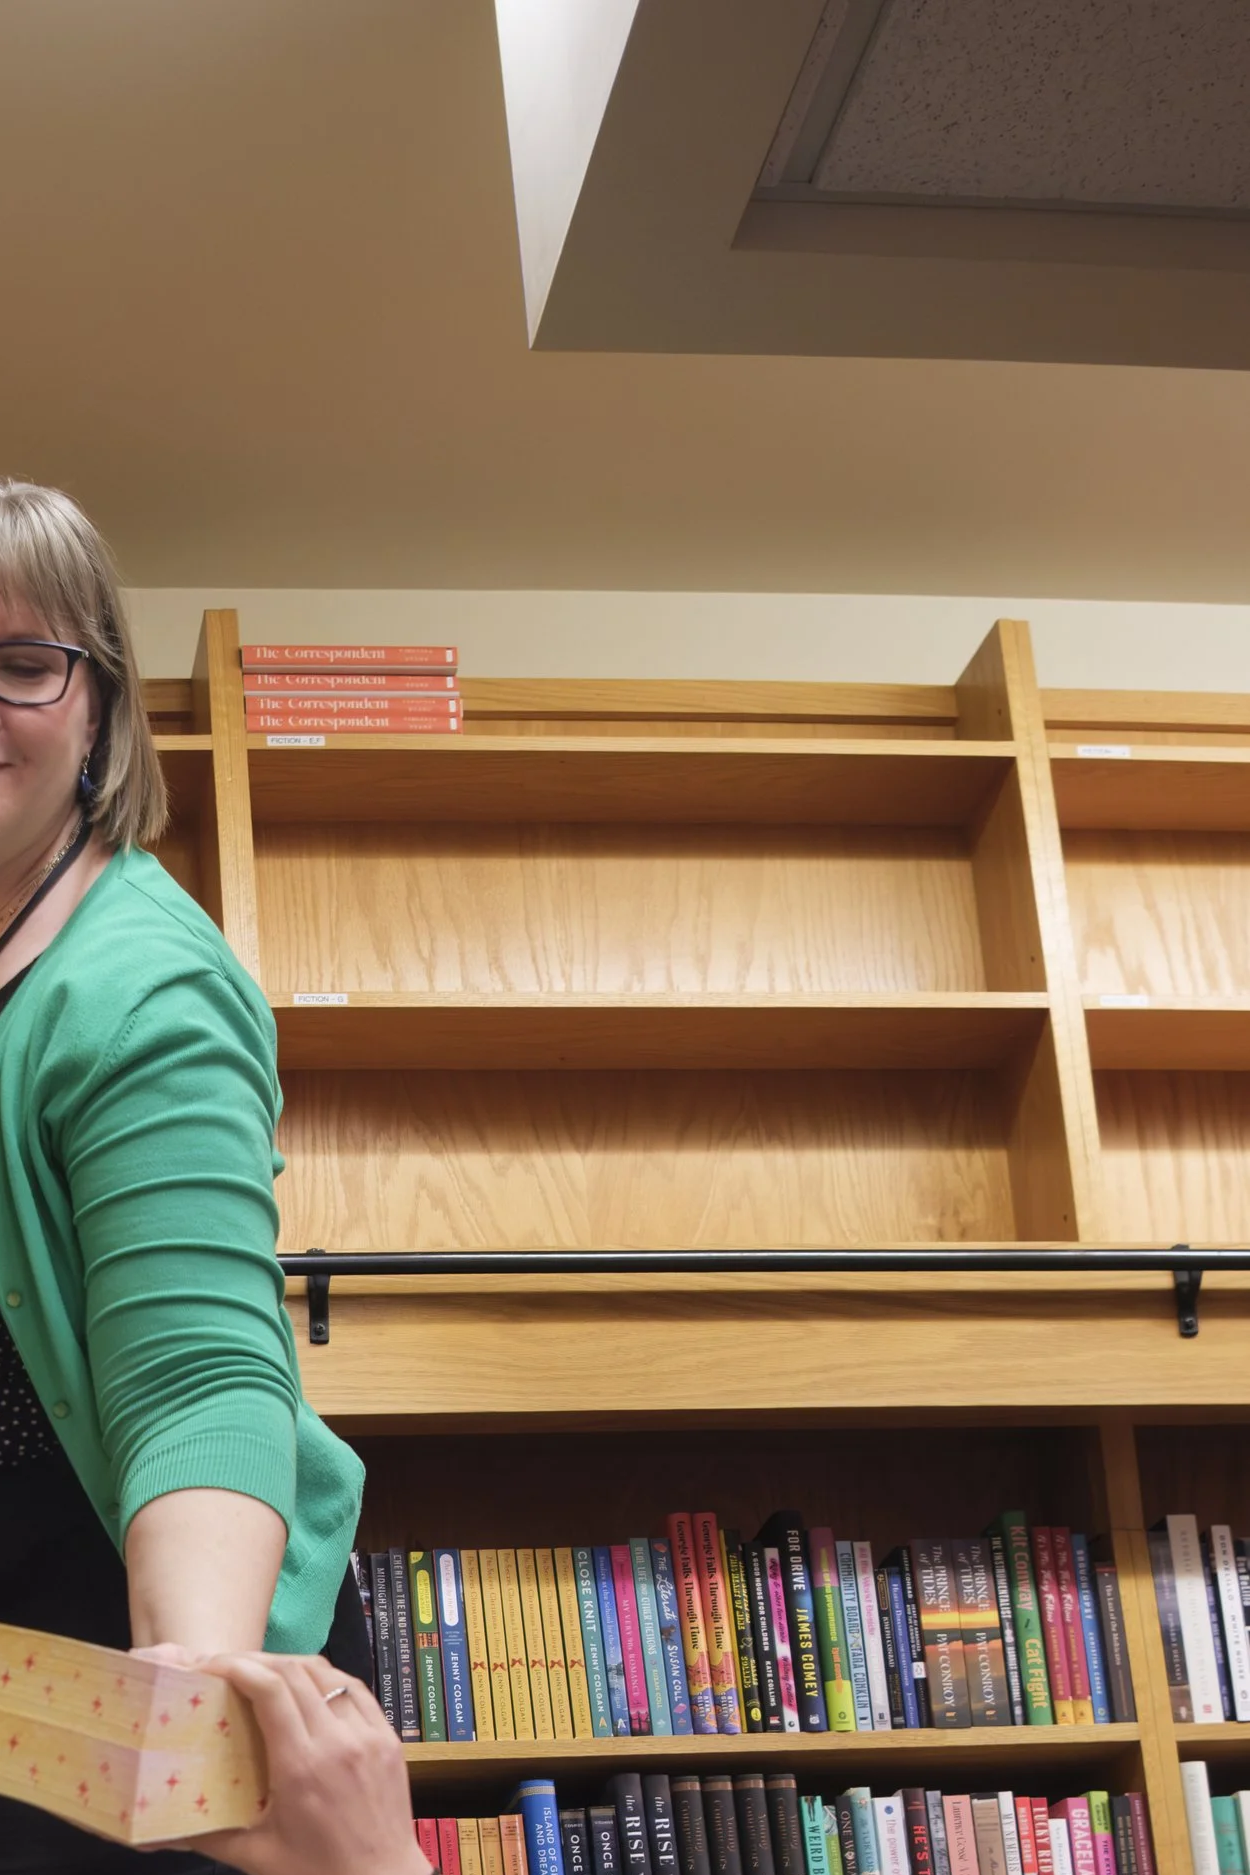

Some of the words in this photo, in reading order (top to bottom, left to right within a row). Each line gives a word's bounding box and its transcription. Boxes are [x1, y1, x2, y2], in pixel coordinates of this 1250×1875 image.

[254, 647, 278, 659] The
[285, 647, 385, 662] Correspondent
[257, 675, 280, 685] The
[286, 675, 386, 688] Correspondent
[258, 698, 282, 709] The
[287, 698, 388, 712] Correspondent
[259, 716, 283, 727] The
[288, 716, 388, 730] Correspondent
[577, 1551, 592, 1596] CLOSE
[1014, 1552, 1034, 1612] Conway
[583, 1600, 596, 1632] KNIT
[796, 1609, 813, 1650] JAMES
[425, 1654, 435, 1684] JENNY
[450, 1651, 460, 1682] JENNY
[589, 1643, 600, 1672] JENNY
[668, 1645, 680, 1672] SUSAN
[1025, 1638, 1041, 1666] Cat
[593, 1674, 605, 1712] COLGAN
[802, 1654, 819, 1698] COMEY
[938, 1654, 956, 1708] CONROY
[978, 1653, 996, 1707] CONROY
[1028, 1668, 1048, 1710] Fight
[427, 1686, 437, 1723] COLGAN
[453, 1684, 464, 1724] COLGAN
[542, 1807, 554, 1844] ISLAND
[625, 1816, 646, 1865] RISE
[654, 1818, 675, 1866] RISE
[808, 1825, 824, 1863] WEIRD
[912, 1825, 929, 1861] HE'S
[570, 1834, 583, 1873] ONCE
[601, 1832, 613, 1870] ONCE
